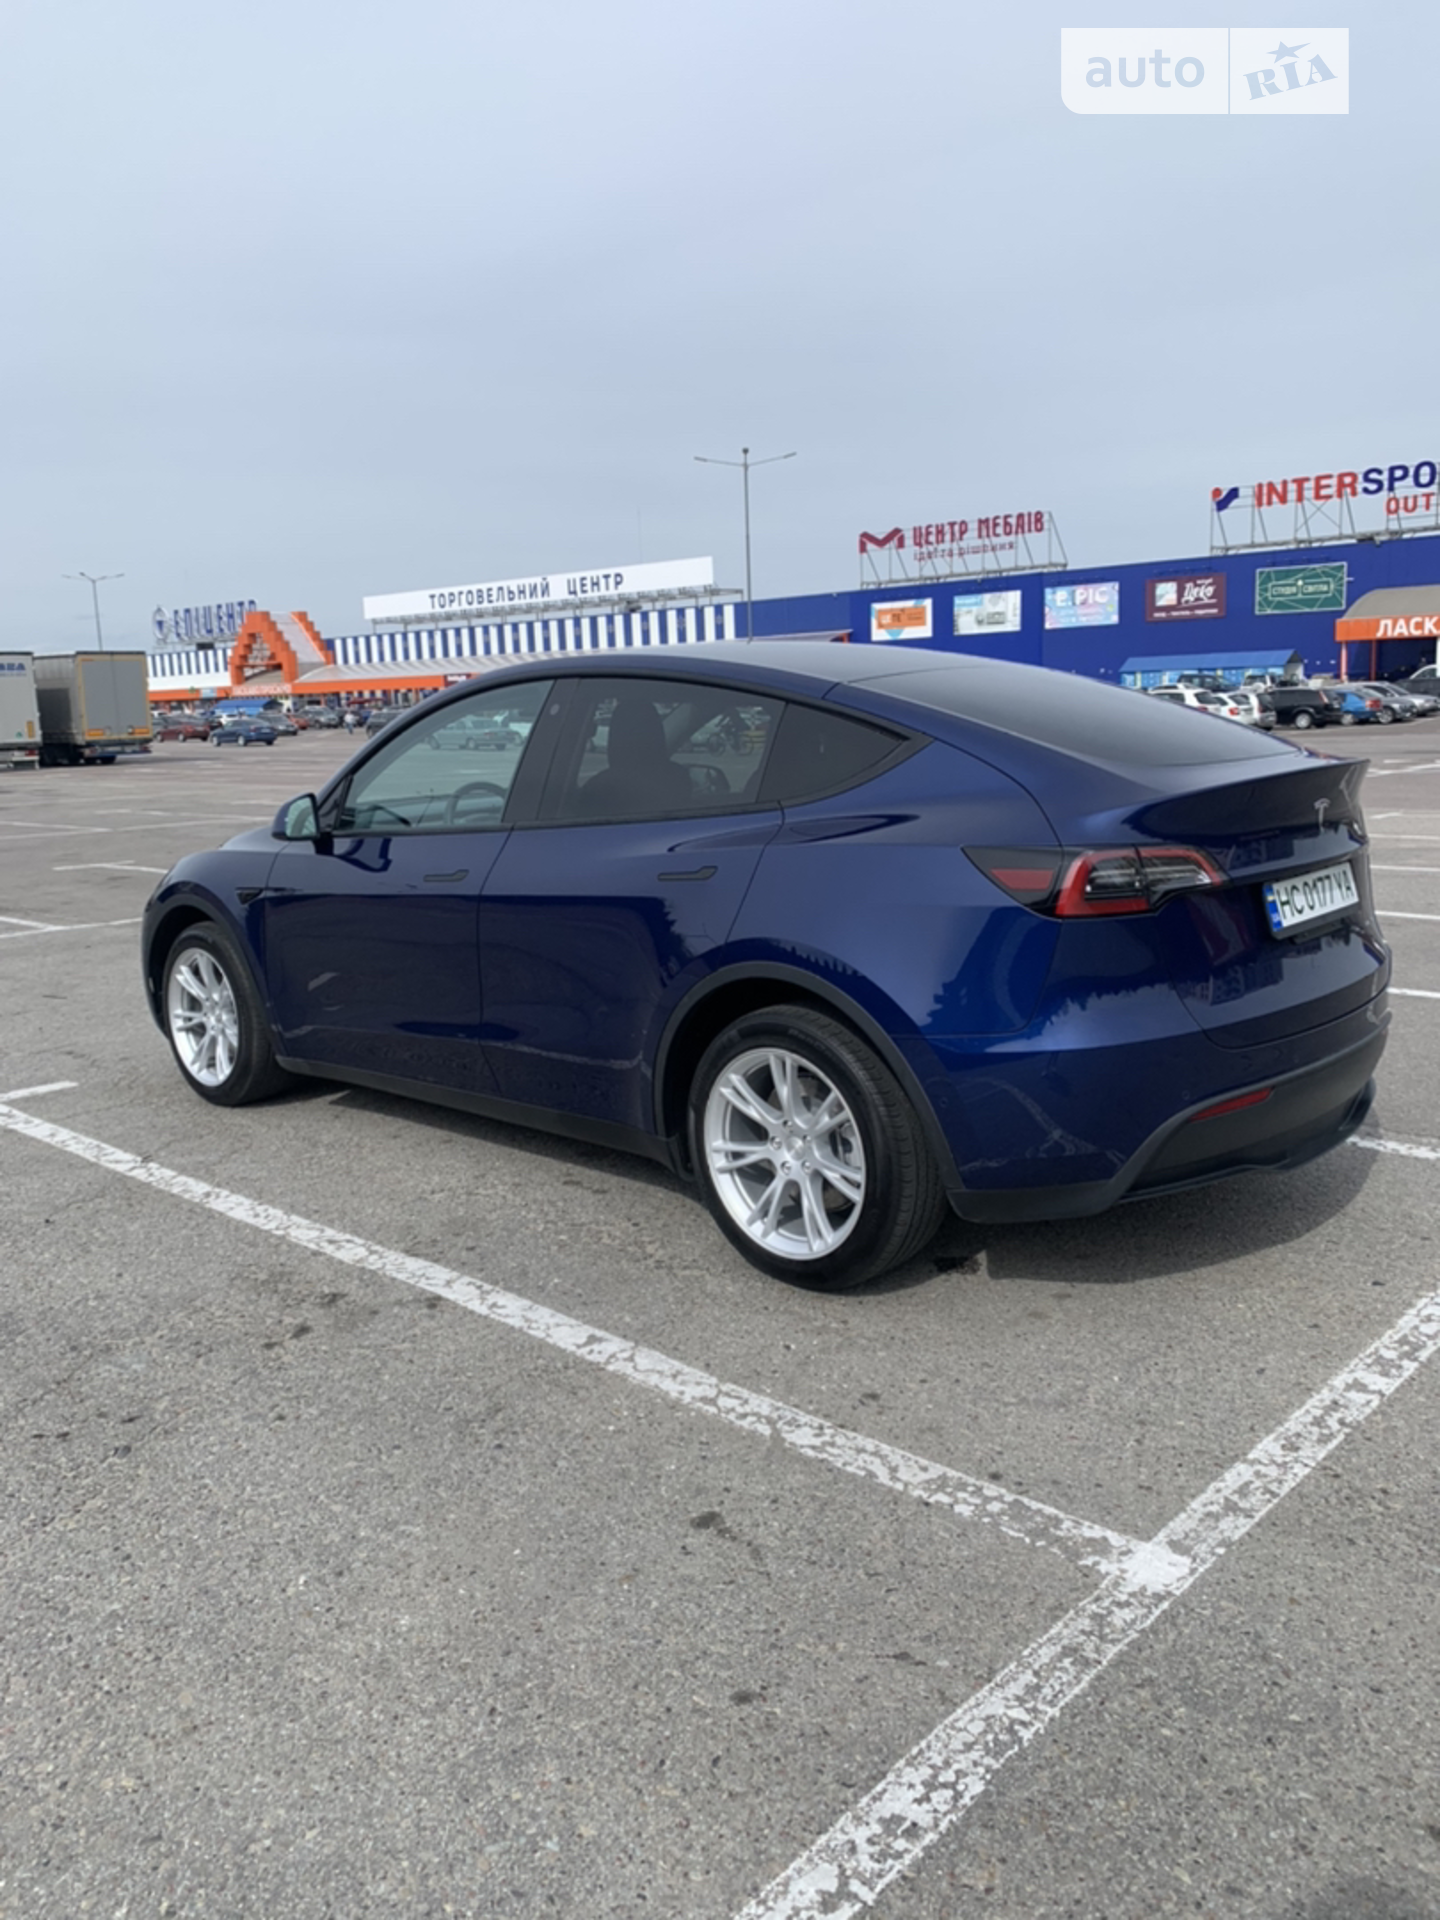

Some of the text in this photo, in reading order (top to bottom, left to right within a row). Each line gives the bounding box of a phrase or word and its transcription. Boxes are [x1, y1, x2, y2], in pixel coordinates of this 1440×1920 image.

[1255, 460, 1437, 508] INTERSPO
[912, 510, 1045, 548] ЦЕНТР МЕБЛІВ
[428, 572, 625, 609] ТОРГОВЕЛЬНИЙ ЦЕНТР
[1376, 616, 1440, 638] ЛАСК
